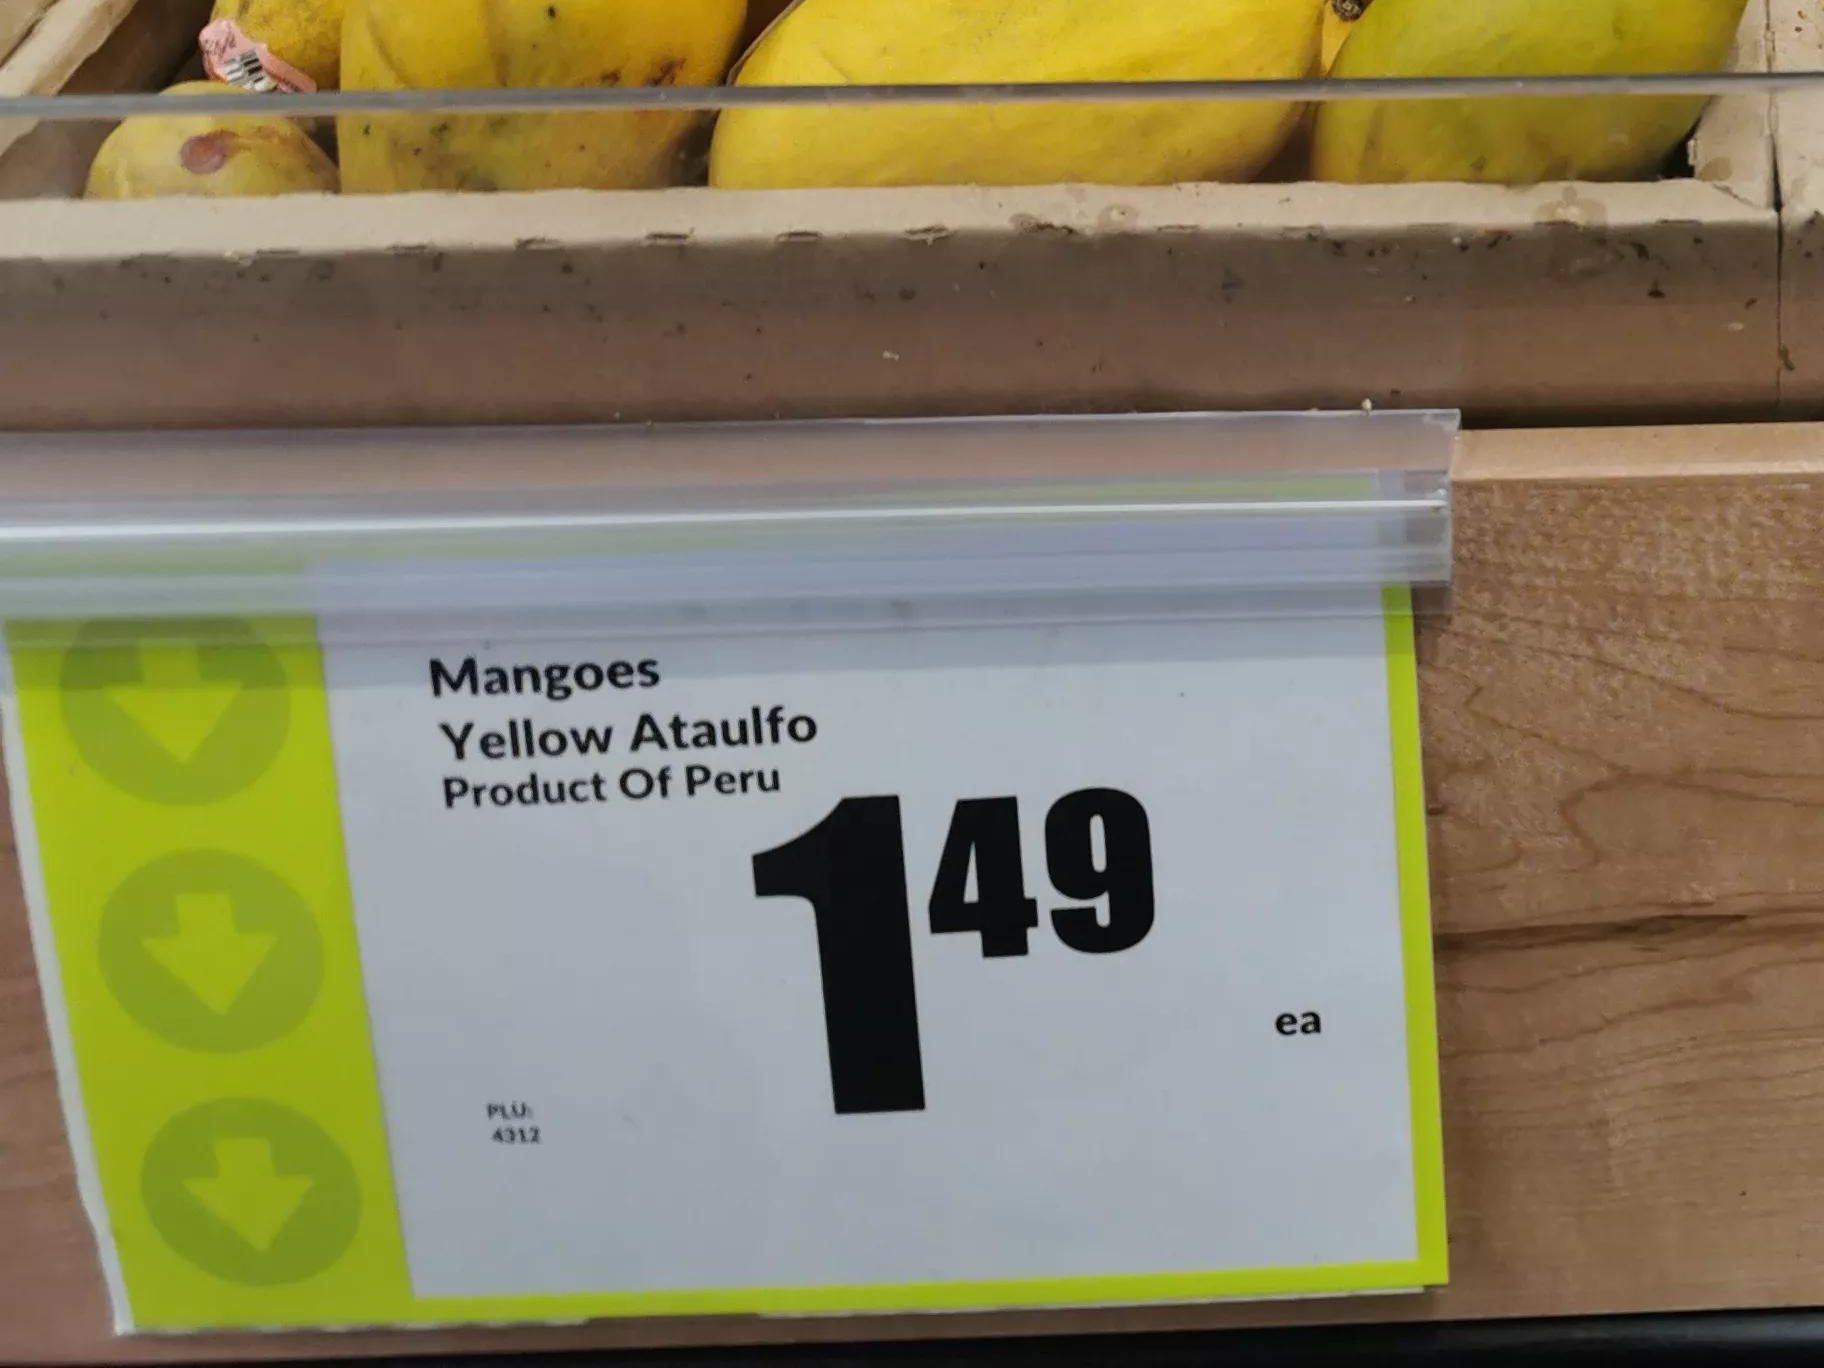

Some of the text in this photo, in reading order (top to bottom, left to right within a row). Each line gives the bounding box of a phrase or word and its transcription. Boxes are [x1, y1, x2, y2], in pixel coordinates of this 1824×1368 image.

[429, 655, 661, 701] Mangoes
[438, 704, 818, 761] Yellow Ataulfo
[442, 762, 781, 810] Product Of Peru
[1274, 1009, 1323, 1037] ea
